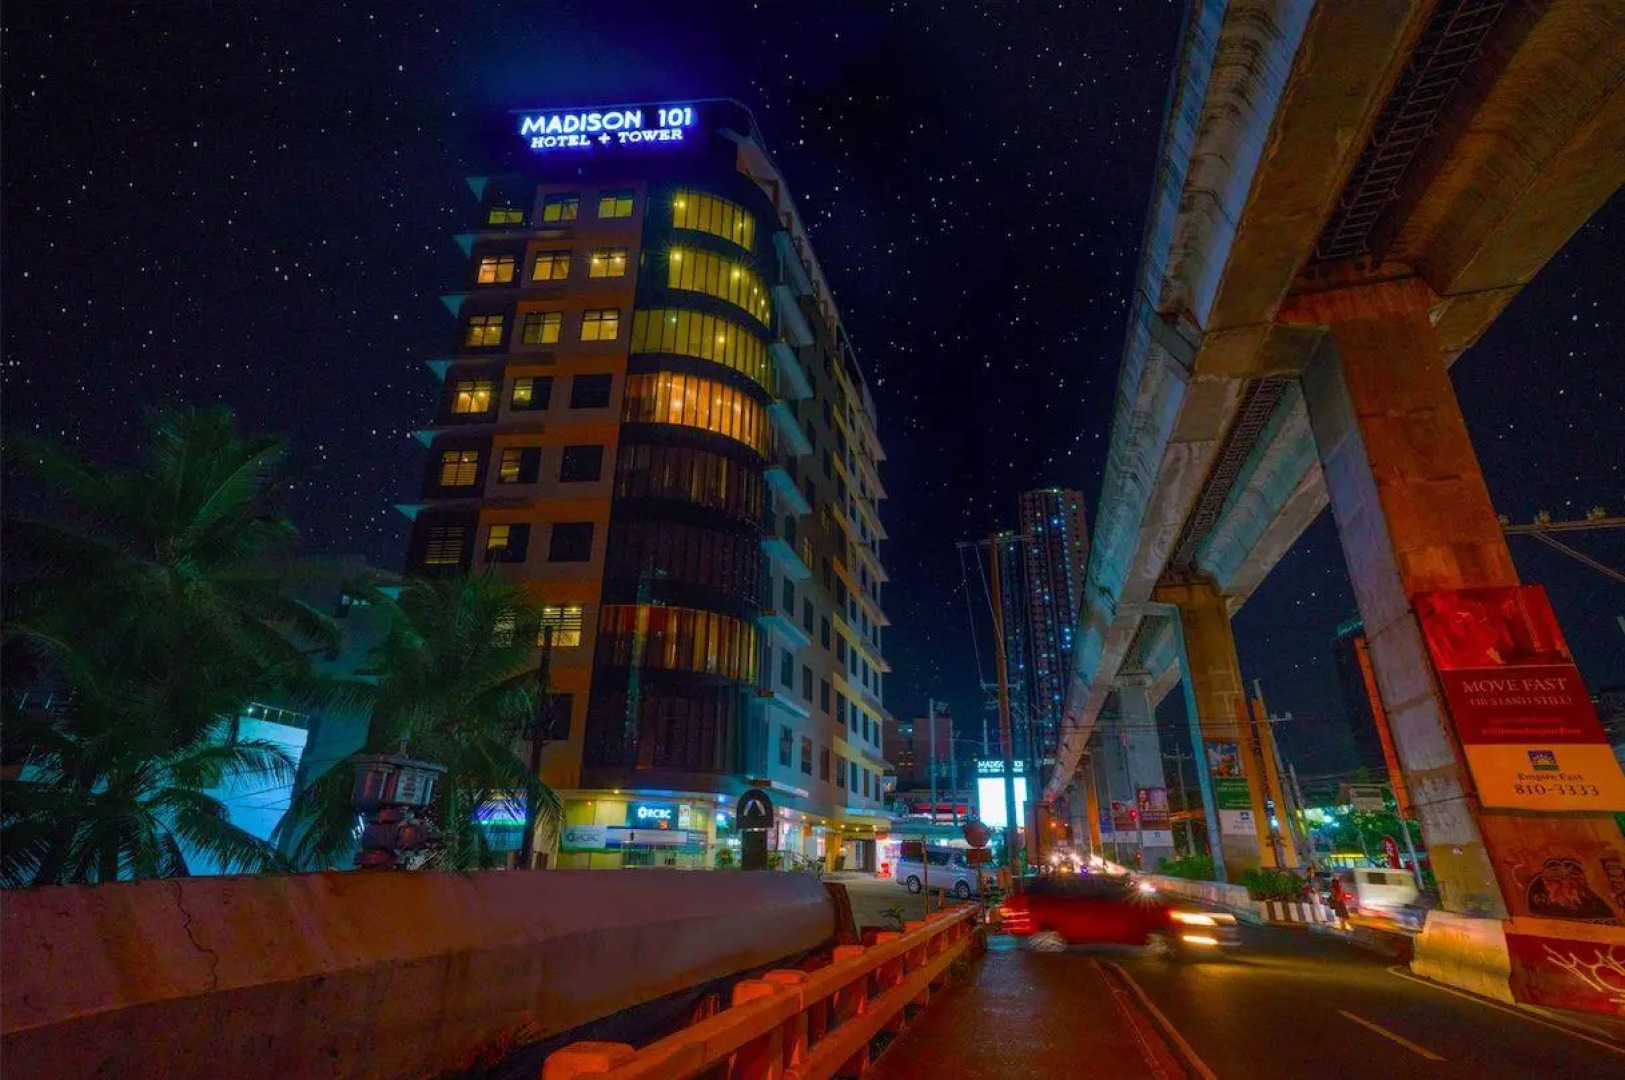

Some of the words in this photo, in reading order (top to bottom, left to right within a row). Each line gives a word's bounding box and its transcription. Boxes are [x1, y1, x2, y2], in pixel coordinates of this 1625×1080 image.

[521, 110, 642, 135] MADISON
[658, 107, 692, 127] 101
[531, 134, 590, 149] HOTEL
[618, 128, 683, 144] TOWER
[1462, 679, 1519, 693] MOVE
[1521, 678, 1567, 691] FAST
[1517, 772, 1557, 781] Empire
[1559, 772, 1583, 781] East
[1514, 784, 1599, 796] 810-3333
[647, 808, 672, 819] RCBC
